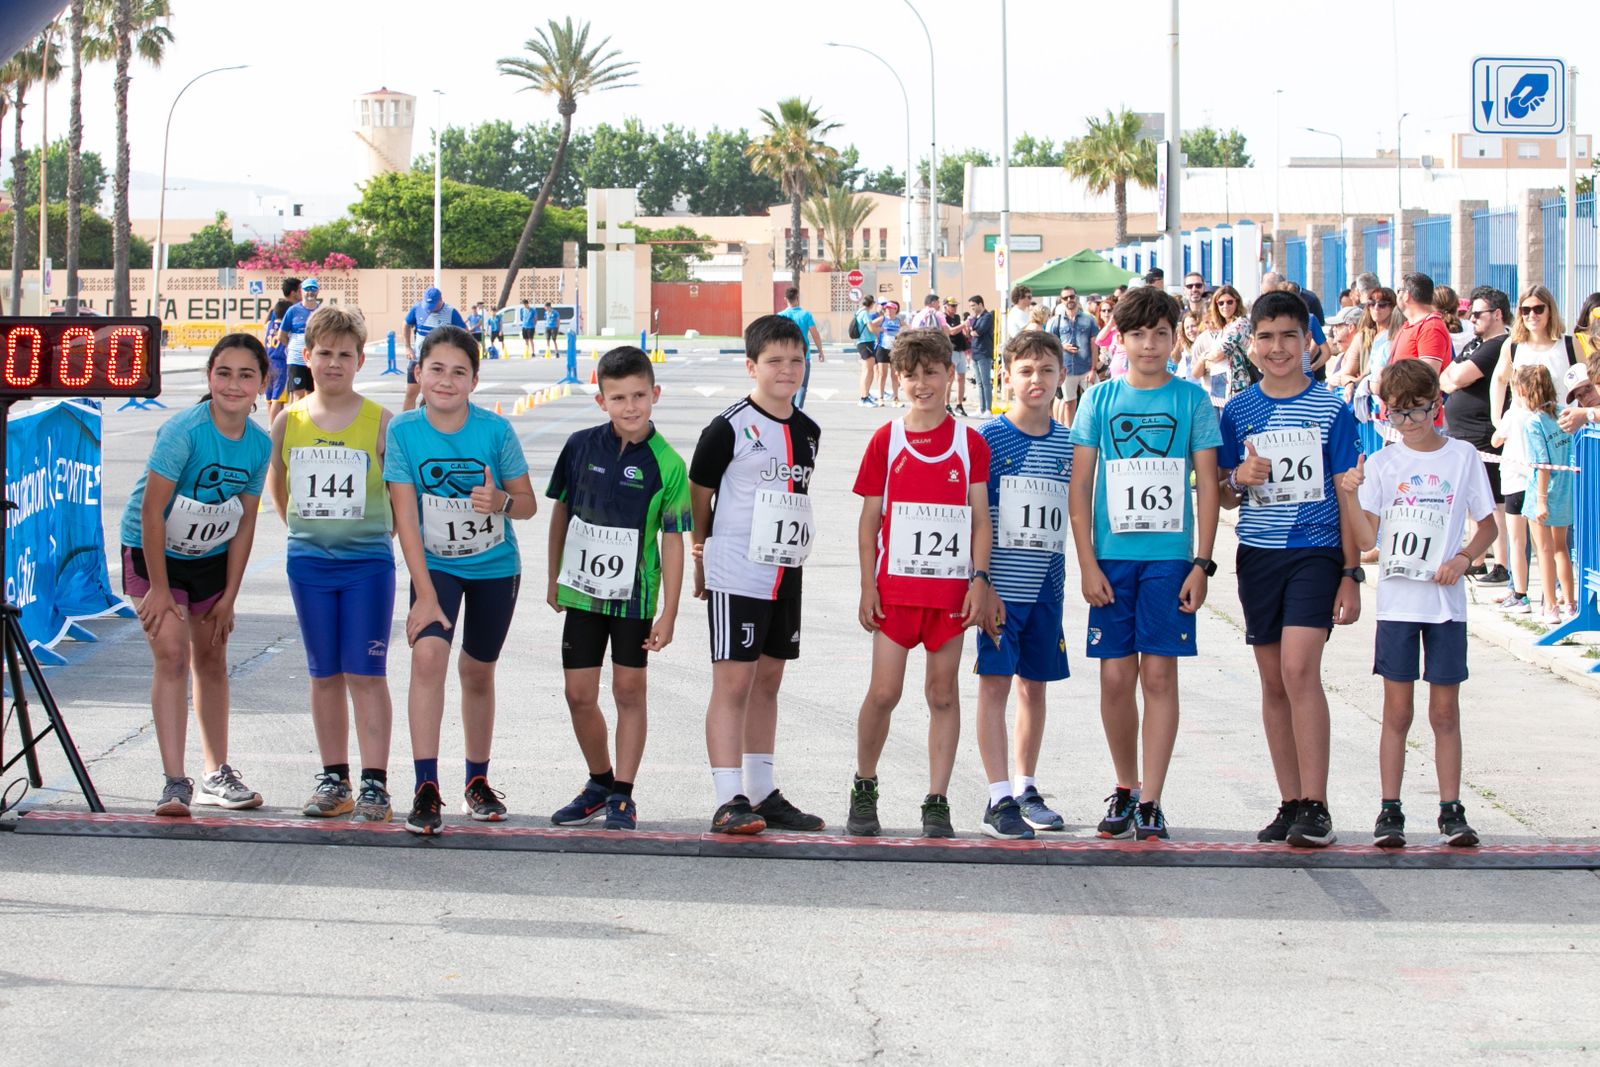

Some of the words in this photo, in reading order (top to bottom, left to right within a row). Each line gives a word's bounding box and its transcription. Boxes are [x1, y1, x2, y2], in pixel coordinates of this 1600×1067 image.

[1265, 430, 1316, 444] MILLA
[311, 449, 361, 461] MILLA
[1127, 461, 1179, 472] MILLA
[54, 457, 101, 505] EPORTES
[760, 457, 813, 488] Jeep
[307, 474, 354, 498] 144
[1025, 479, 1067, 495] MILLA
[1125, 485, 1173, 510] 163
[198, 500, 240, 514] MILLA
[916, 506, 966, 519] MILLA
[1021, 504, 1062, 531] 110
[1397, 507, 1445, 526] MILLA
[184, 521, 230, 541] 109
[445, 515, 494, 541] 134
[582, 525, 633, 541] MILLA
[772, 520, 810, 547] 120
[912, 531, 960, 557] 124
[1391, 531, 1432, 561] 101
[579, 549, 624, 579] 169
